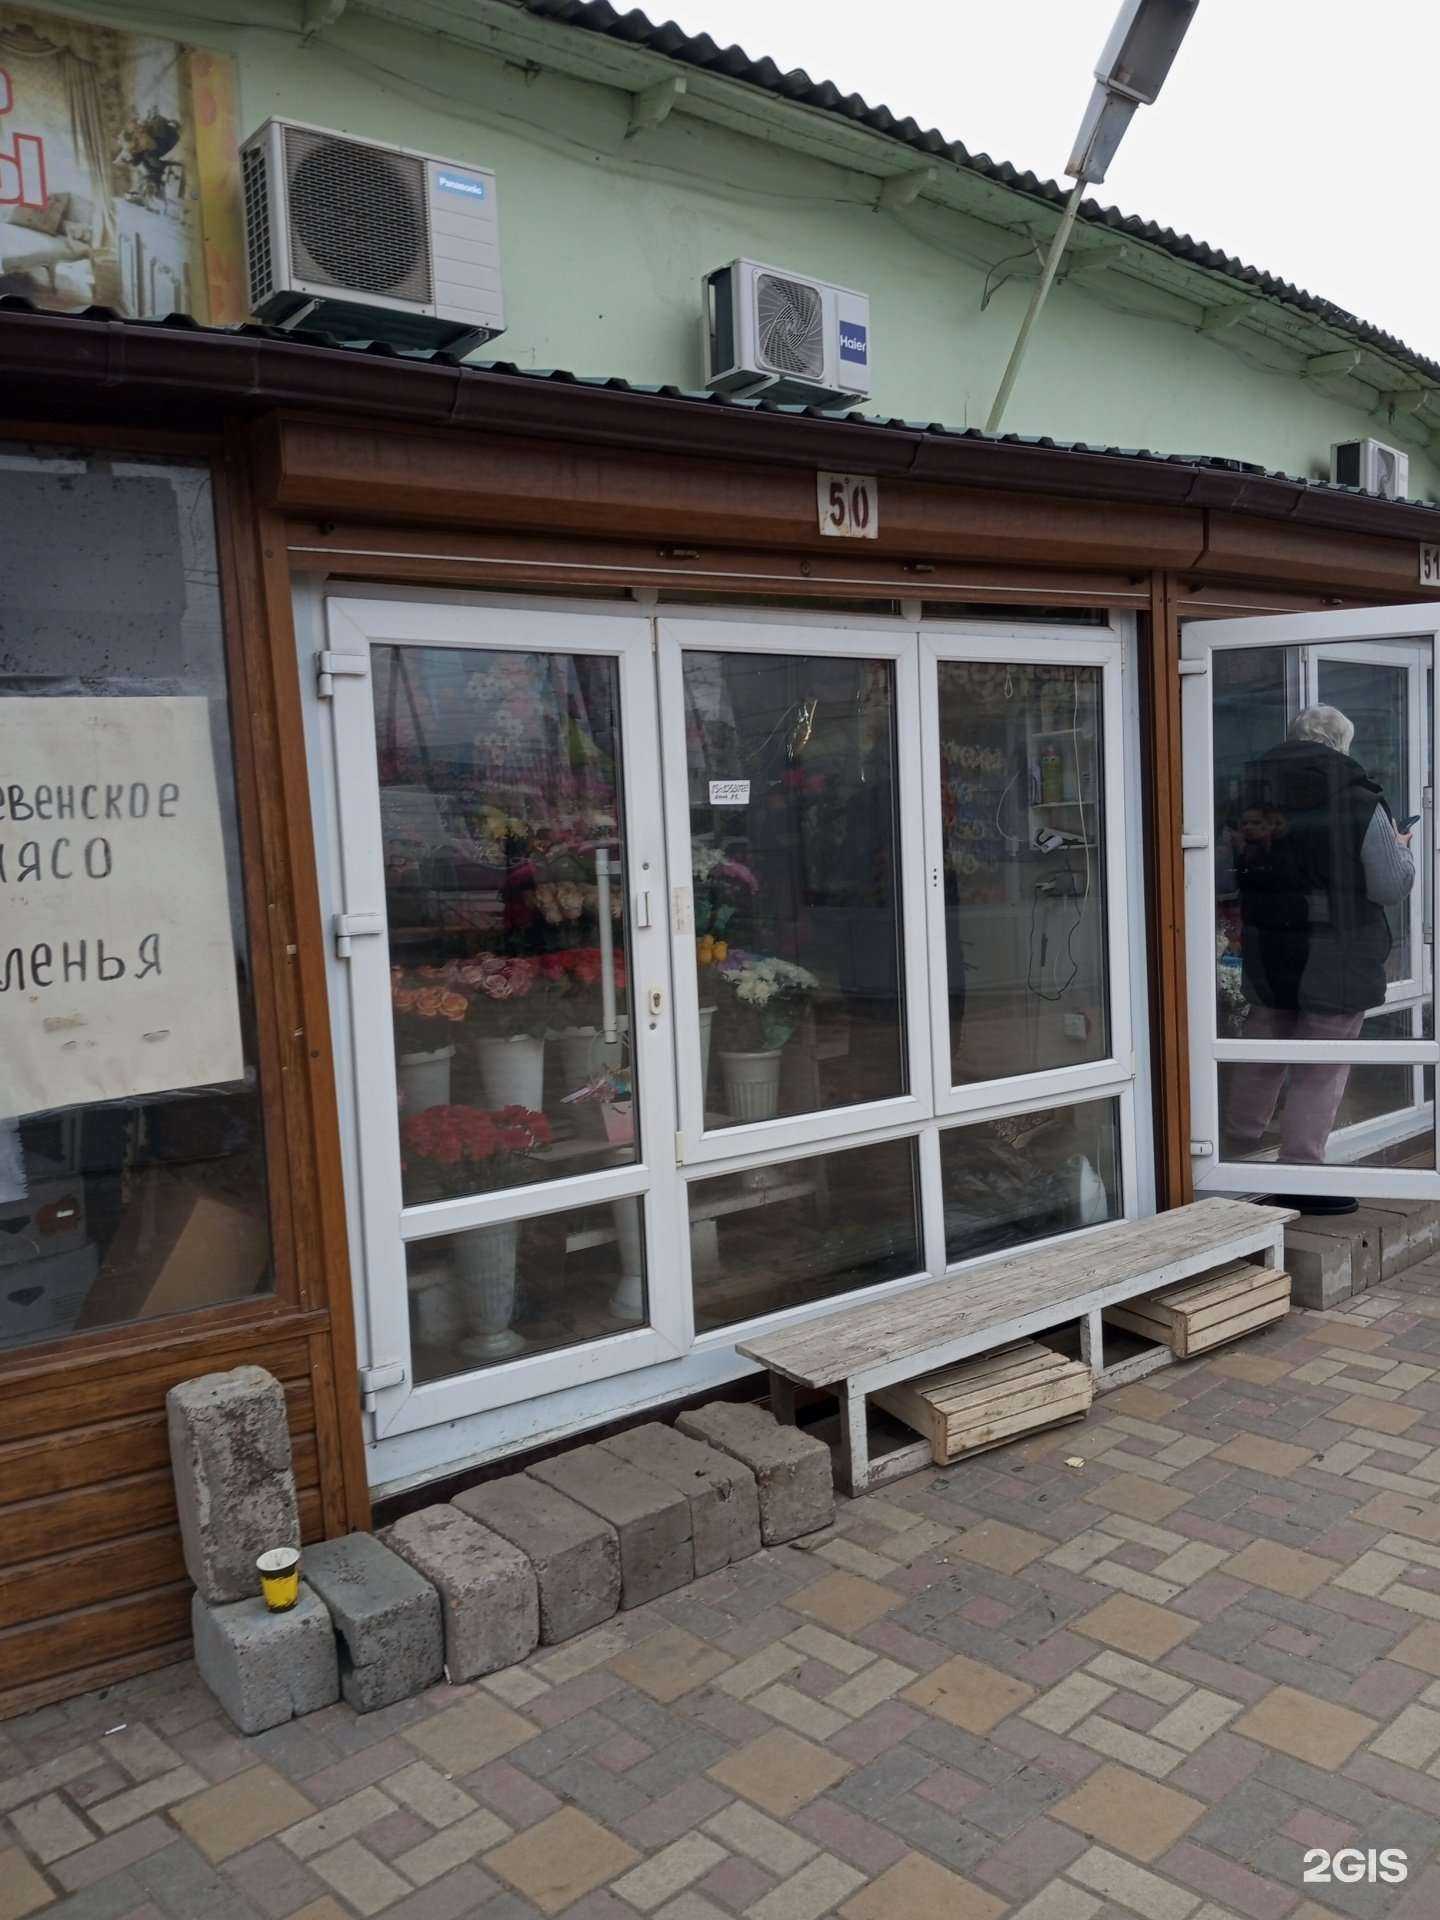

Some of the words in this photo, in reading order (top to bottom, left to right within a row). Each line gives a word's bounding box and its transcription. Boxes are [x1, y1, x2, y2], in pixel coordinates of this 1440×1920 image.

[839, 334, 867, 353] Haier
[829, 481, 870, 529] 50
[0, 781, 181, 823] венское
